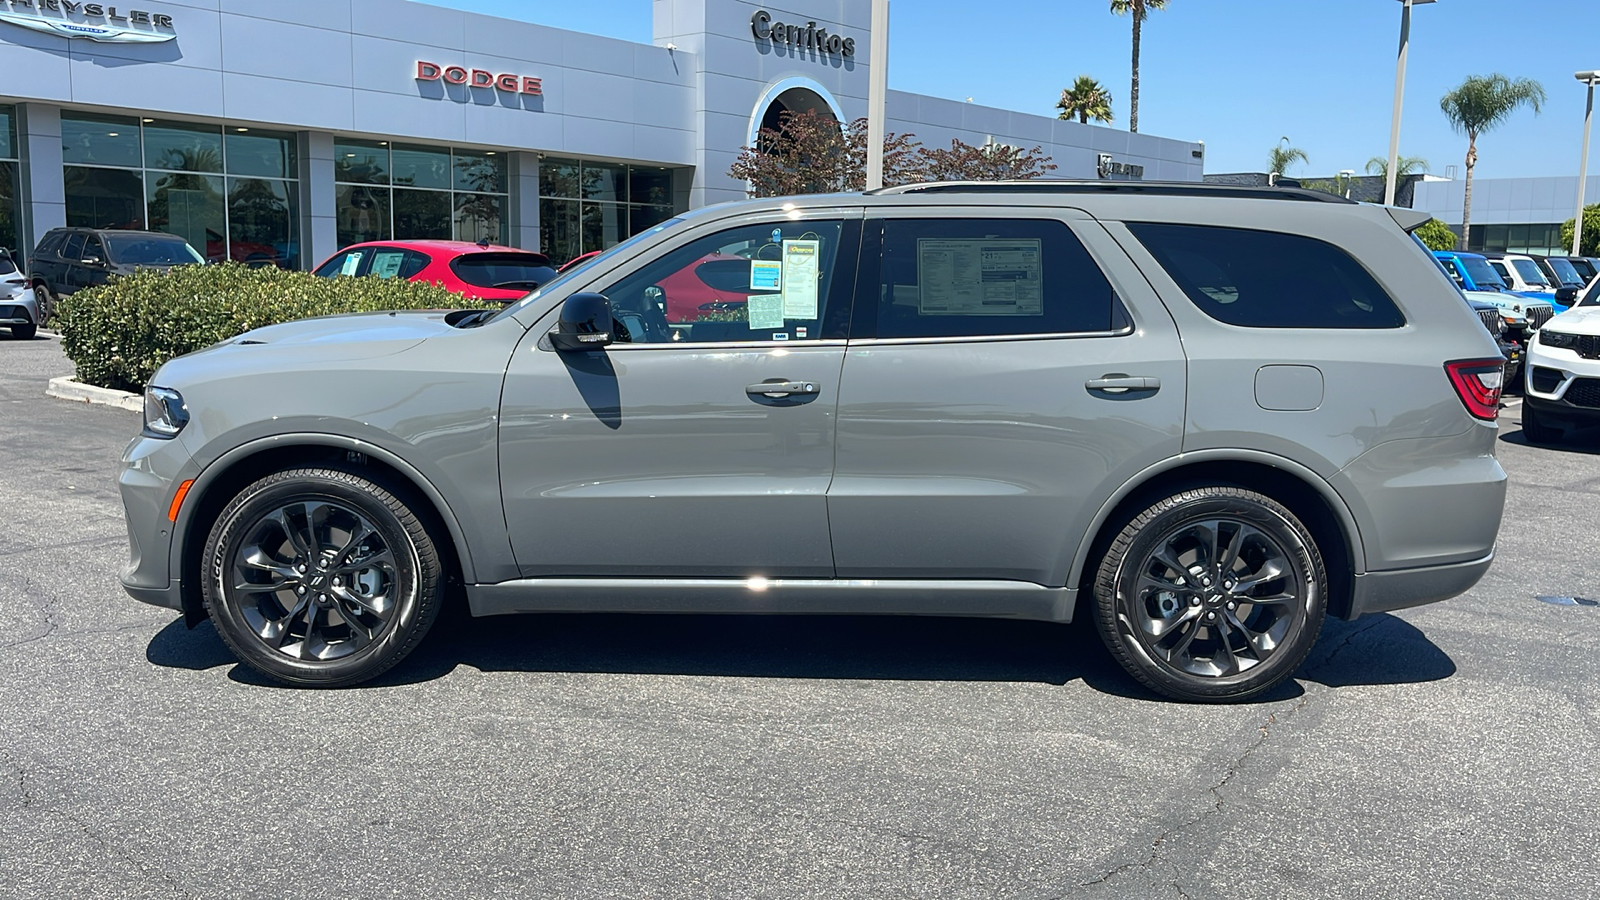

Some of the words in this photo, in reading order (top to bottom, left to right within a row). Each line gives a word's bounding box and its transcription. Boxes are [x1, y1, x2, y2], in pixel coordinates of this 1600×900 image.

[751, 10, 855, 56] Cerritos
[416, 61, 542, 95] DODGE
[1111, 163, 1144, 177] RAM
[213, 511, 244, 589] SCORPION
